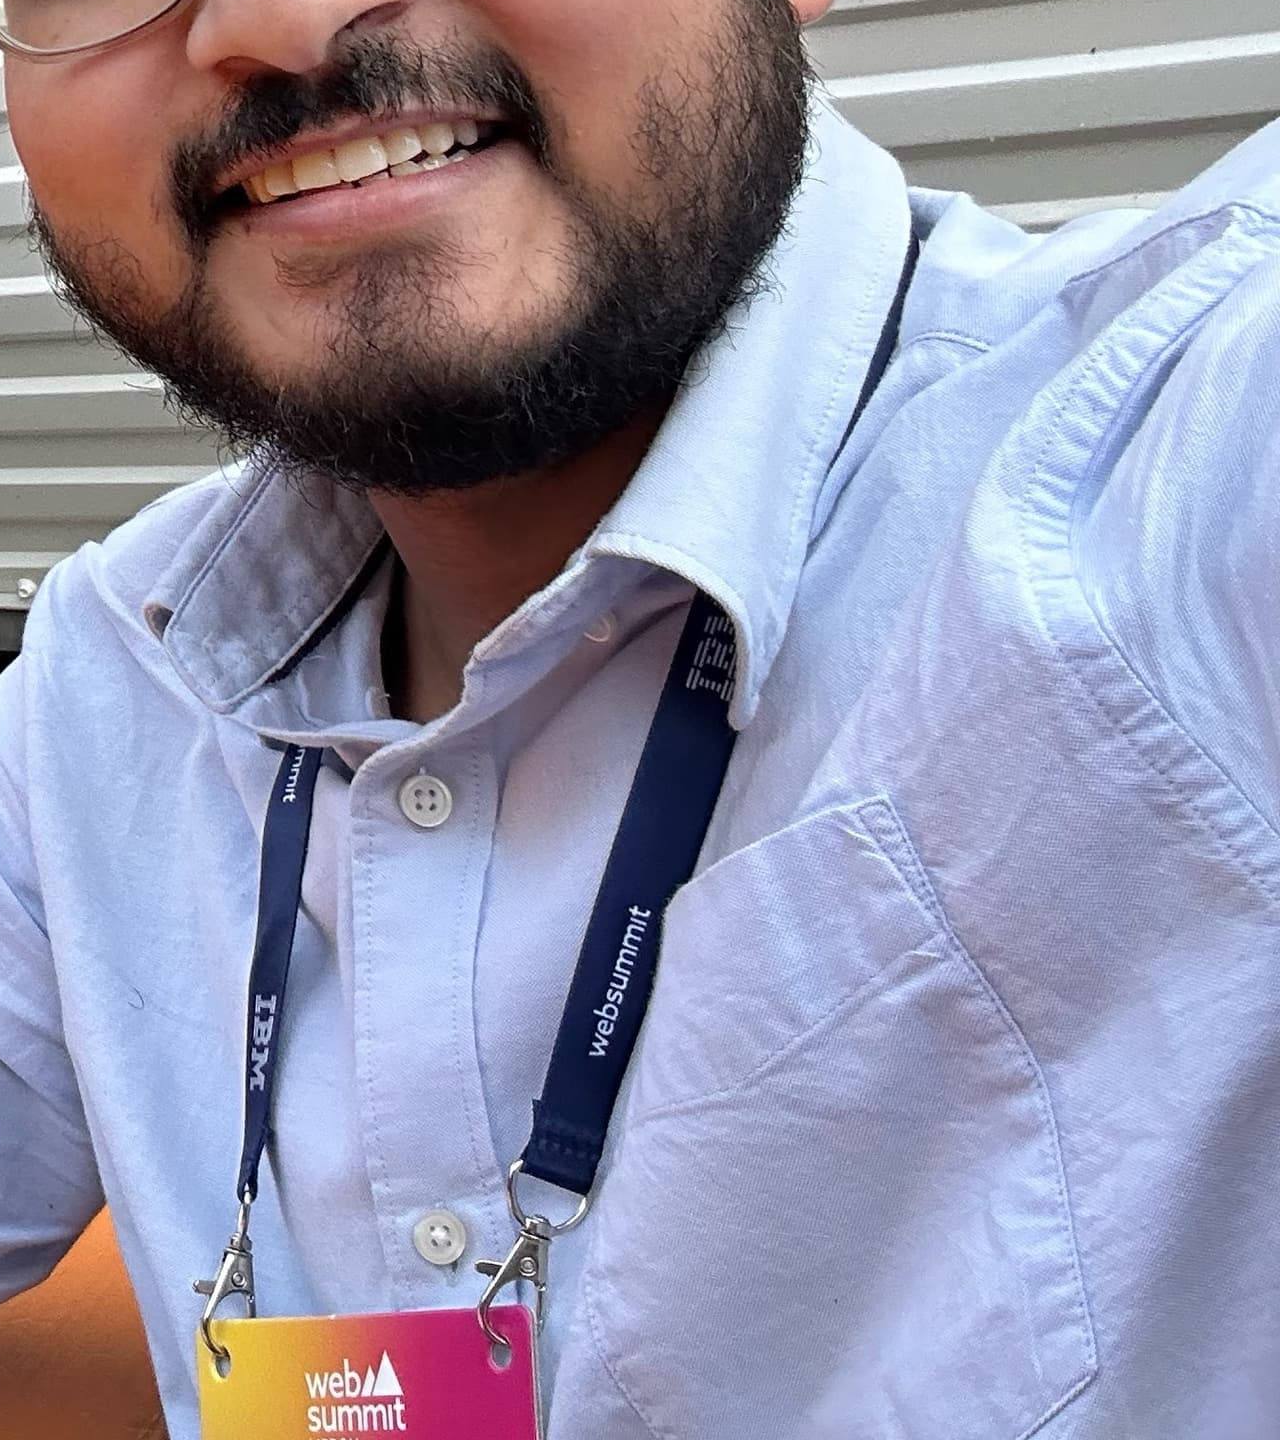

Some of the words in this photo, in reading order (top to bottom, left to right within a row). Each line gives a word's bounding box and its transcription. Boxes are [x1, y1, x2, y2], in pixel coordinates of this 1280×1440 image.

[589, 904, 652, 1057] websummit
[250, 994, 277, 1091] IBM
[304, 1358, 361, 1399] web
[307, 1396, 407, 1433] summit
